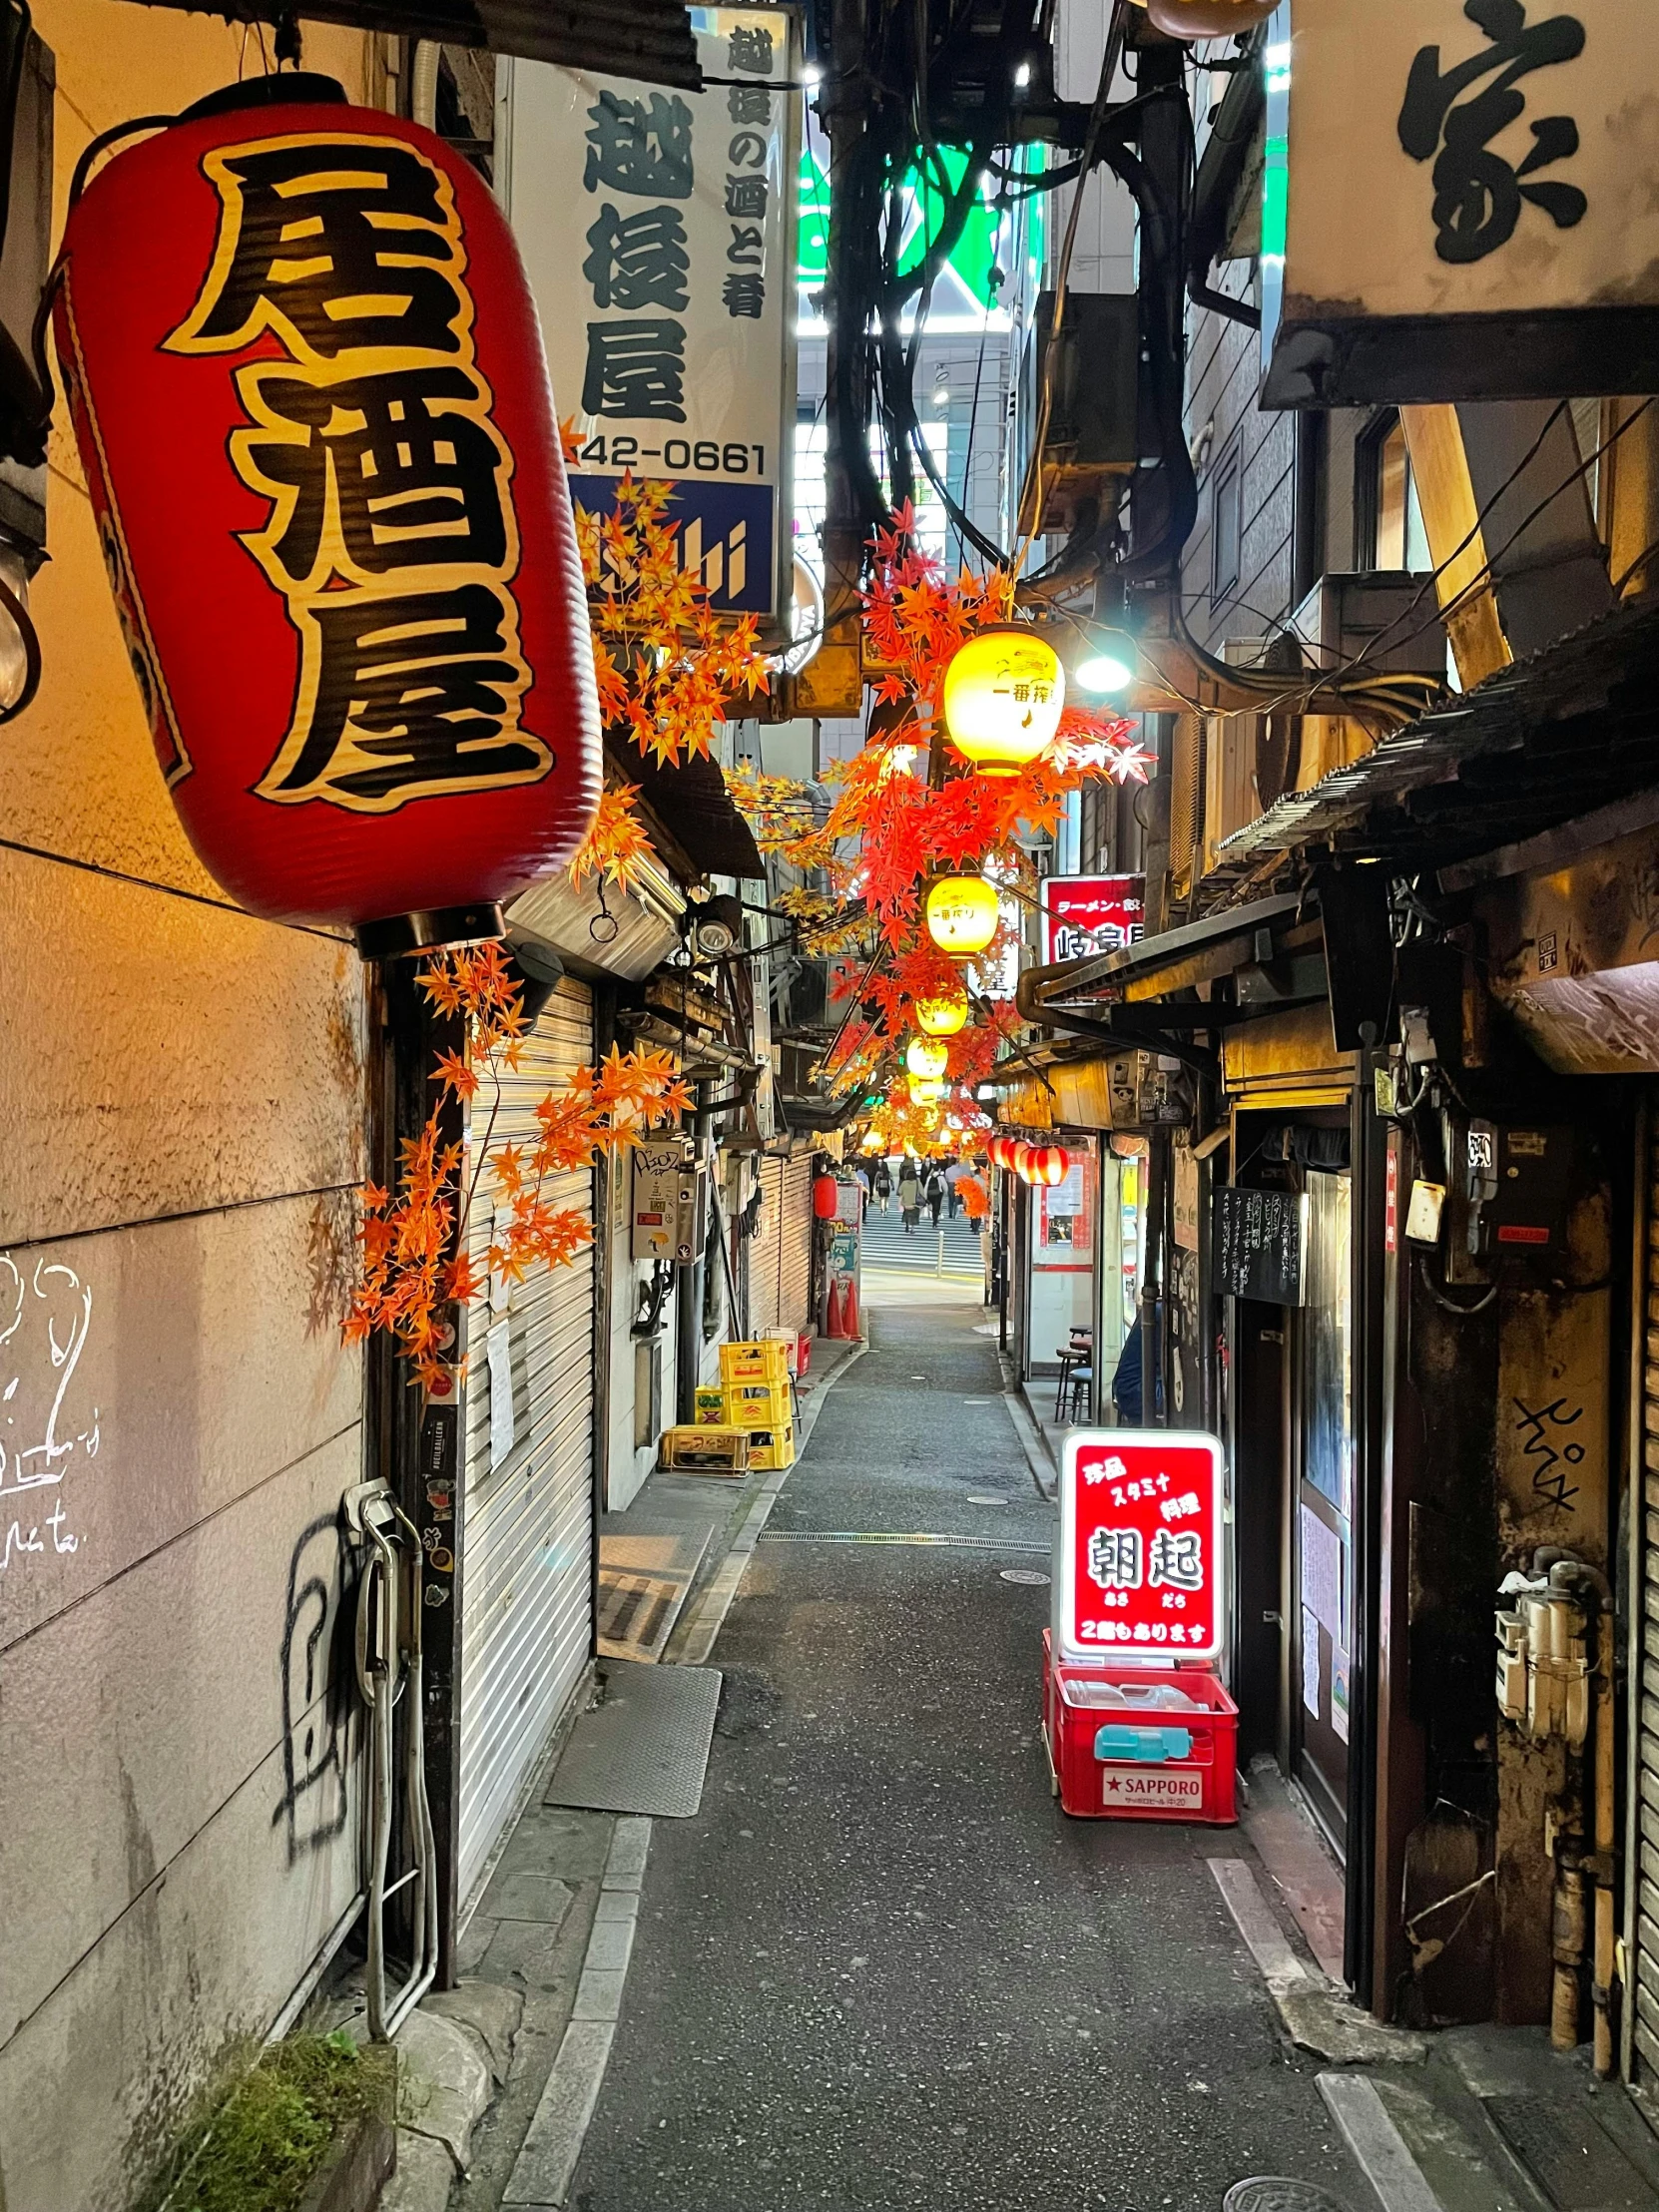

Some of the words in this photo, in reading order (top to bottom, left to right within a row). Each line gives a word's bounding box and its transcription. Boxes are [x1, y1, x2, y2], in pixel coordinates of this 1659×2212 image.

[1397, 0, 1588, 264] 家
[722, 25, 774, 318] 越後の酒と肴
[582, 90, 695, 423] 越後屋
[161, 132, 555, 815] 居酒屋
[566, 435, 766, 475] 42-0661
[993, 685, 1057, 705] 一番搾
[1058, 898, 1145, 912] ラーメン・餃
[1110, 1472, 1171, 1507] スタミナ
[1089, 1527, 1203, 1590] 朝起
[1125, 1778, 1200, 1795] SAPPORO
